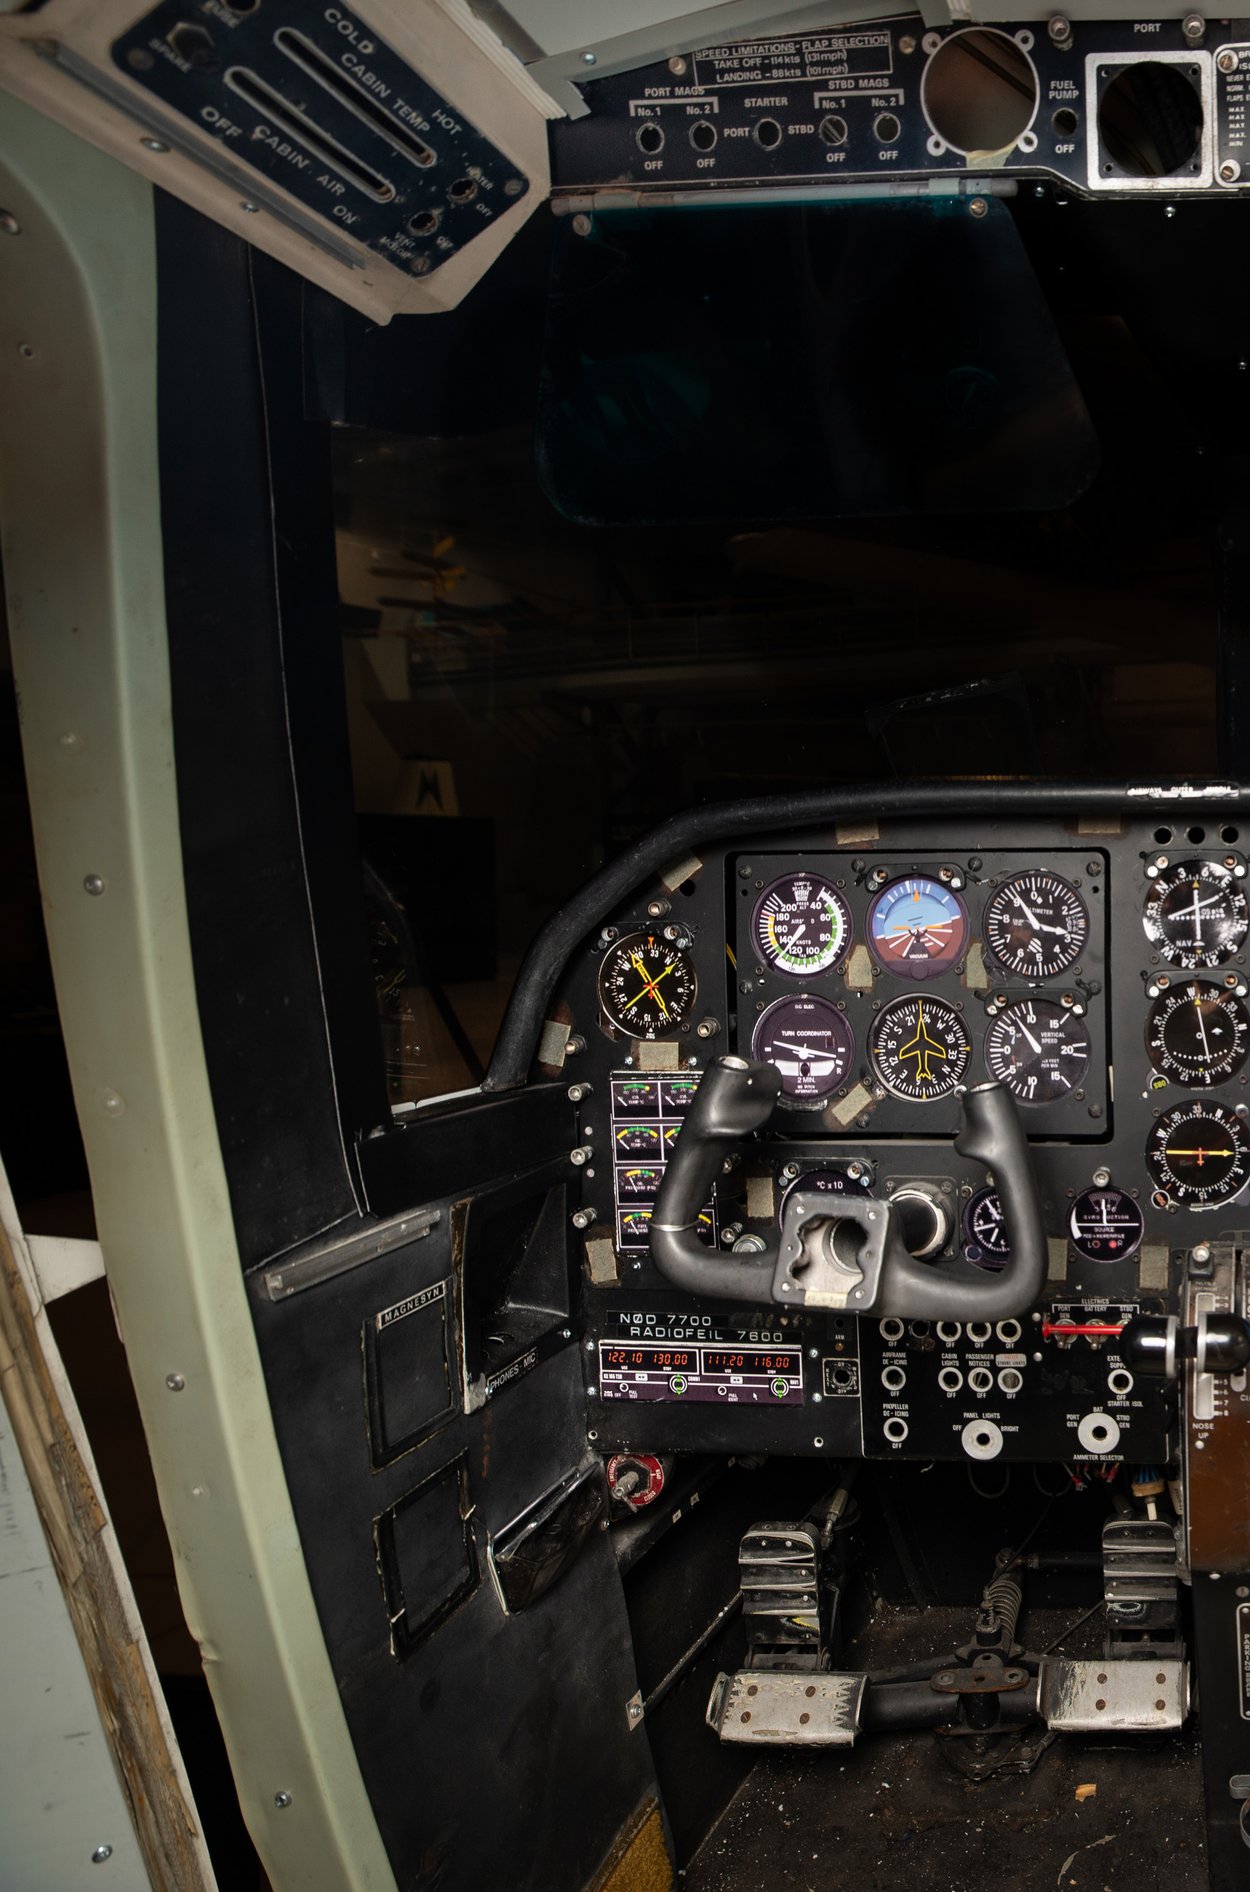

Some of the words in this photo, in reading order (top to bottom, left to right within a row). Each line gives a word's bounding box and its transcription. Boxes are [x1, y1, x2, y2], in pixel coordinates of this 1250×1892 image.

[323, 8, 375, 55] COLD
[1133, 23, 1161, 33] PORT
[695, 47, 730, 59] SPEED
[802, 38, 829, 50] FLAP
[831, 33, 889, 47] SELECTION
[713, 59, 741, 70] TAKE
[804, 50, 847, 63] (131mph)
[716, 71, 762, 83] LANDING
[806, 63, 849, 77] (101mph)
[828, 78, 856, 90] STBD
[859, 78, 889, 89] MAGS
[1050, 80, 1076, 90] FUEL
[340, 52, 392, 99] CABIN
[392, 98, 431, 134] TEMP
[644, 86, 672, 98] PORT
[674, 86, 705, 97] MAGS
[1048, 89, 1080, 100] PUMP
[744, 96, 788, 108] STARTER
[200, 105, 243, 140] OFF
[431, 108, 463, 136] HOT
[724, 126, 750, 138] PORT
[787, 124, 815, 136] STBD
[1055, 144, 1075, 154] OFF
[253, 124, 310, 170] CABIN
[315, 171, 347, 198] AIR
[825, 153, 846, 163] OFF
[878, 150, 899, 161] OFF
[644, 160, 663, 171] OFF
[696, 158, 716, 169] OFF
[332, 203, 358, 226] ON
[781, 904, 797, 912] 200
[810, 902, 822, 910] 40
[776, 913, 789, 921] 180
[774, 925, 788, 933] 160
[789, 946, 803, 954] 120
[1027, 1015, 1036, 1024] 10
[1050, 1020, 1059, 1029] 15
[1061, 1045, 1074, 1054] 20
[384, 1287, 441, 1323] MAGNESYN
[619, 1313, 657, 1325] NØD
[667, 1314, 712, 1326] 7700
[630, 1327, 723, 1340] RADIOFEIL
[737, 1330, 783, 1342] 7600
[607, 1352, 643, 1363] 122.10
[653, 1353, 688, 1365] 130.00
[708, 1354, 743, 1367] 111.20
[754, 1356, 789, 1368] 116.00
